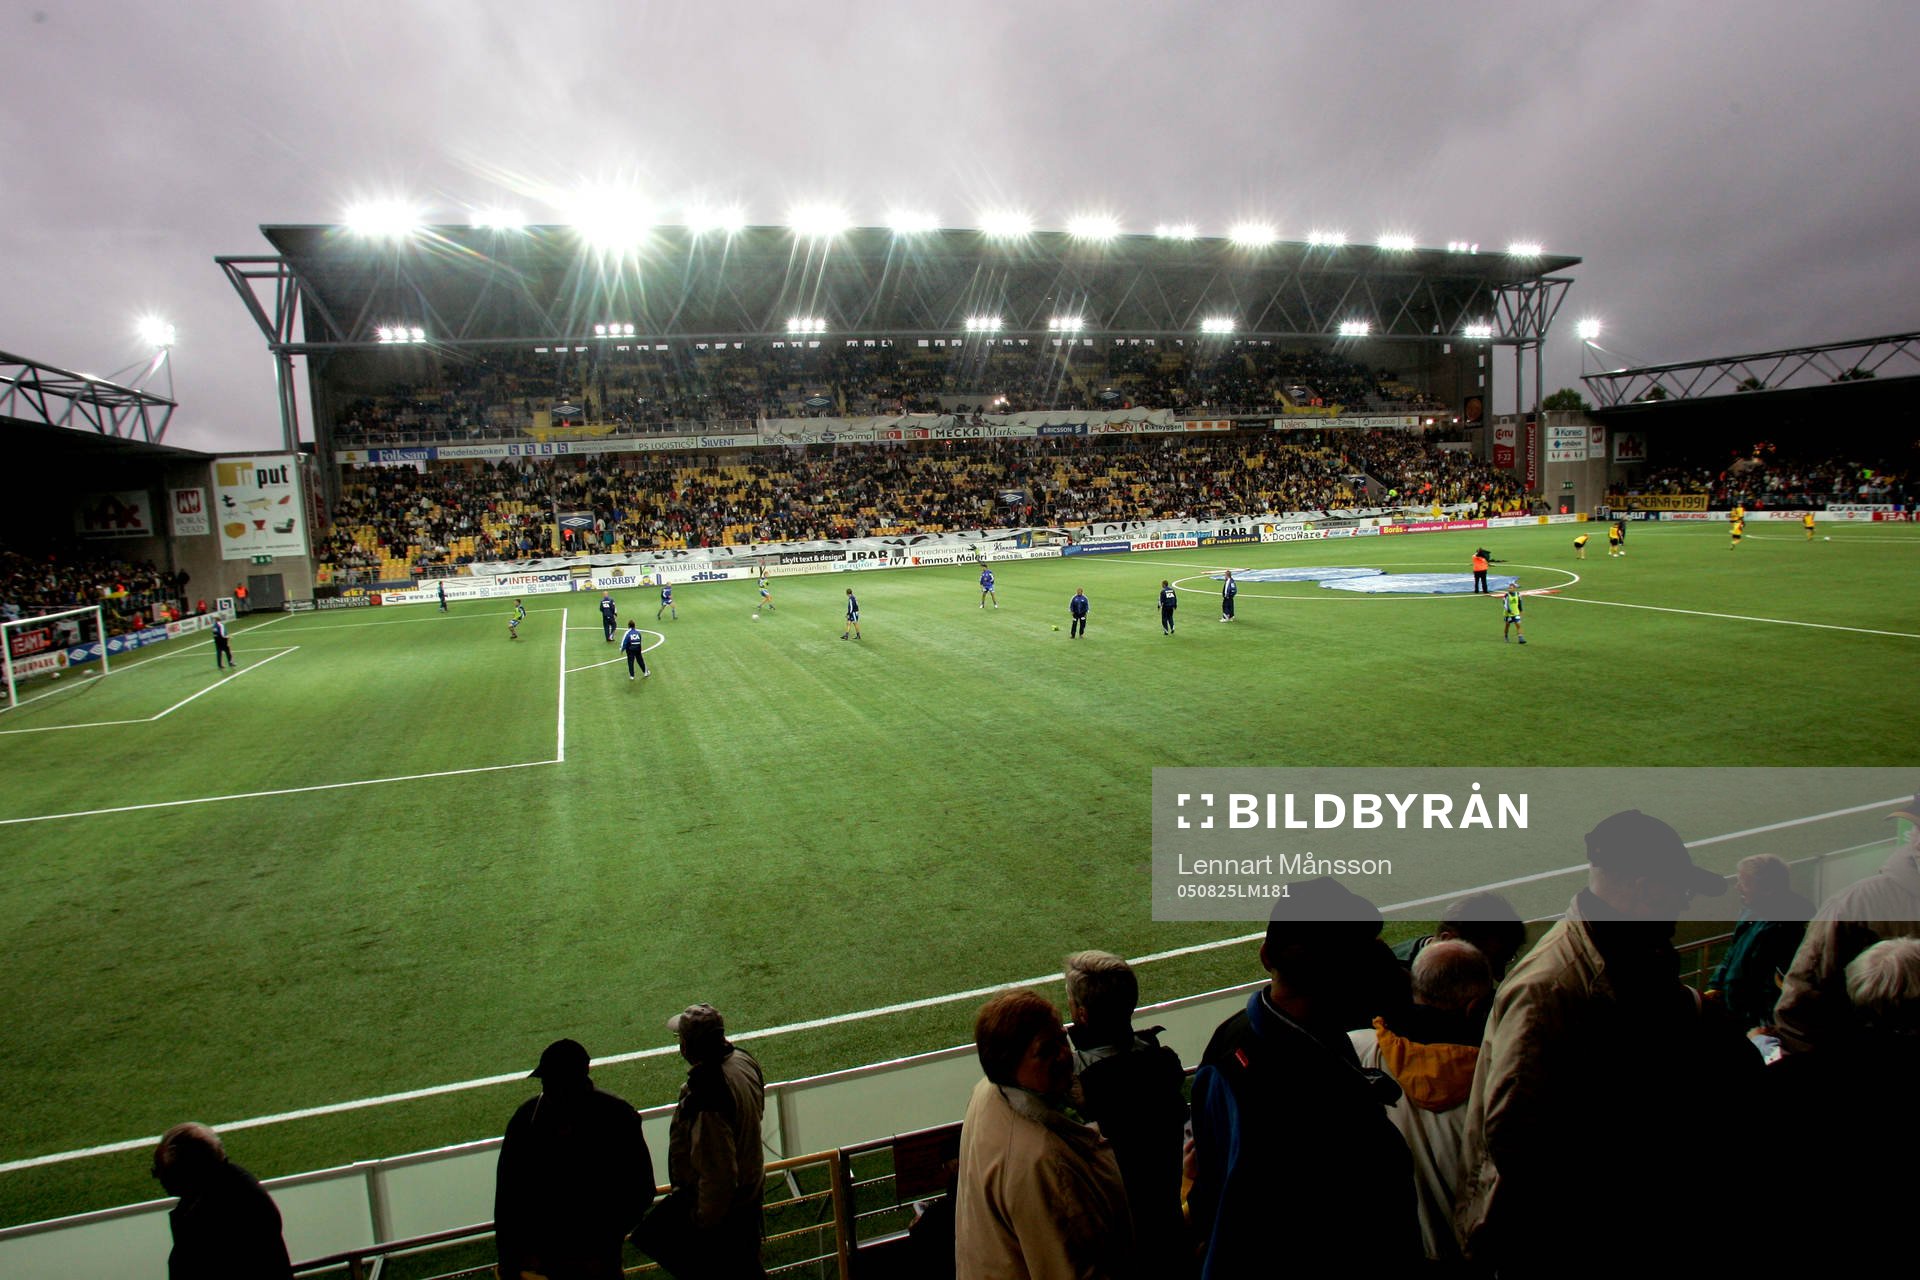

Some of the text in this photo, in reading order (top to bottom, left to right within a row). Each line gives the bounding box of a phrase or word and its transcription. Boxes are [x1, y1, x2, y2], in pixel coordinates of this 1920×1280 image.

[936, 428, 980, 438] MECKA
[651, 440, 692, 449] LOGISTICS
[700, 437, 735, 448] SILVENT
[379, 449, 428, 461] Folksam
[439, 447, 504, 457] Handelsbanken
[1682, 496, 1705, 509] 1991
[1272, 531, 1321, 541] DocuWare
[1131, 538, 1197, 550] PERFECT BILVÅRD
[782, 556, 798, 566] skylt
[820, 553, 843, 562] design
[889, 557, 908, 566] IVT
[914, 552, 987, 566] Kimmos Måleri
[508, 573, 569, 585] INTERSPORT
[598, 575, 636, 586] NORRBY
[691, 571, 728, 582] stiba
[629, 633, 641, 641] ICA
